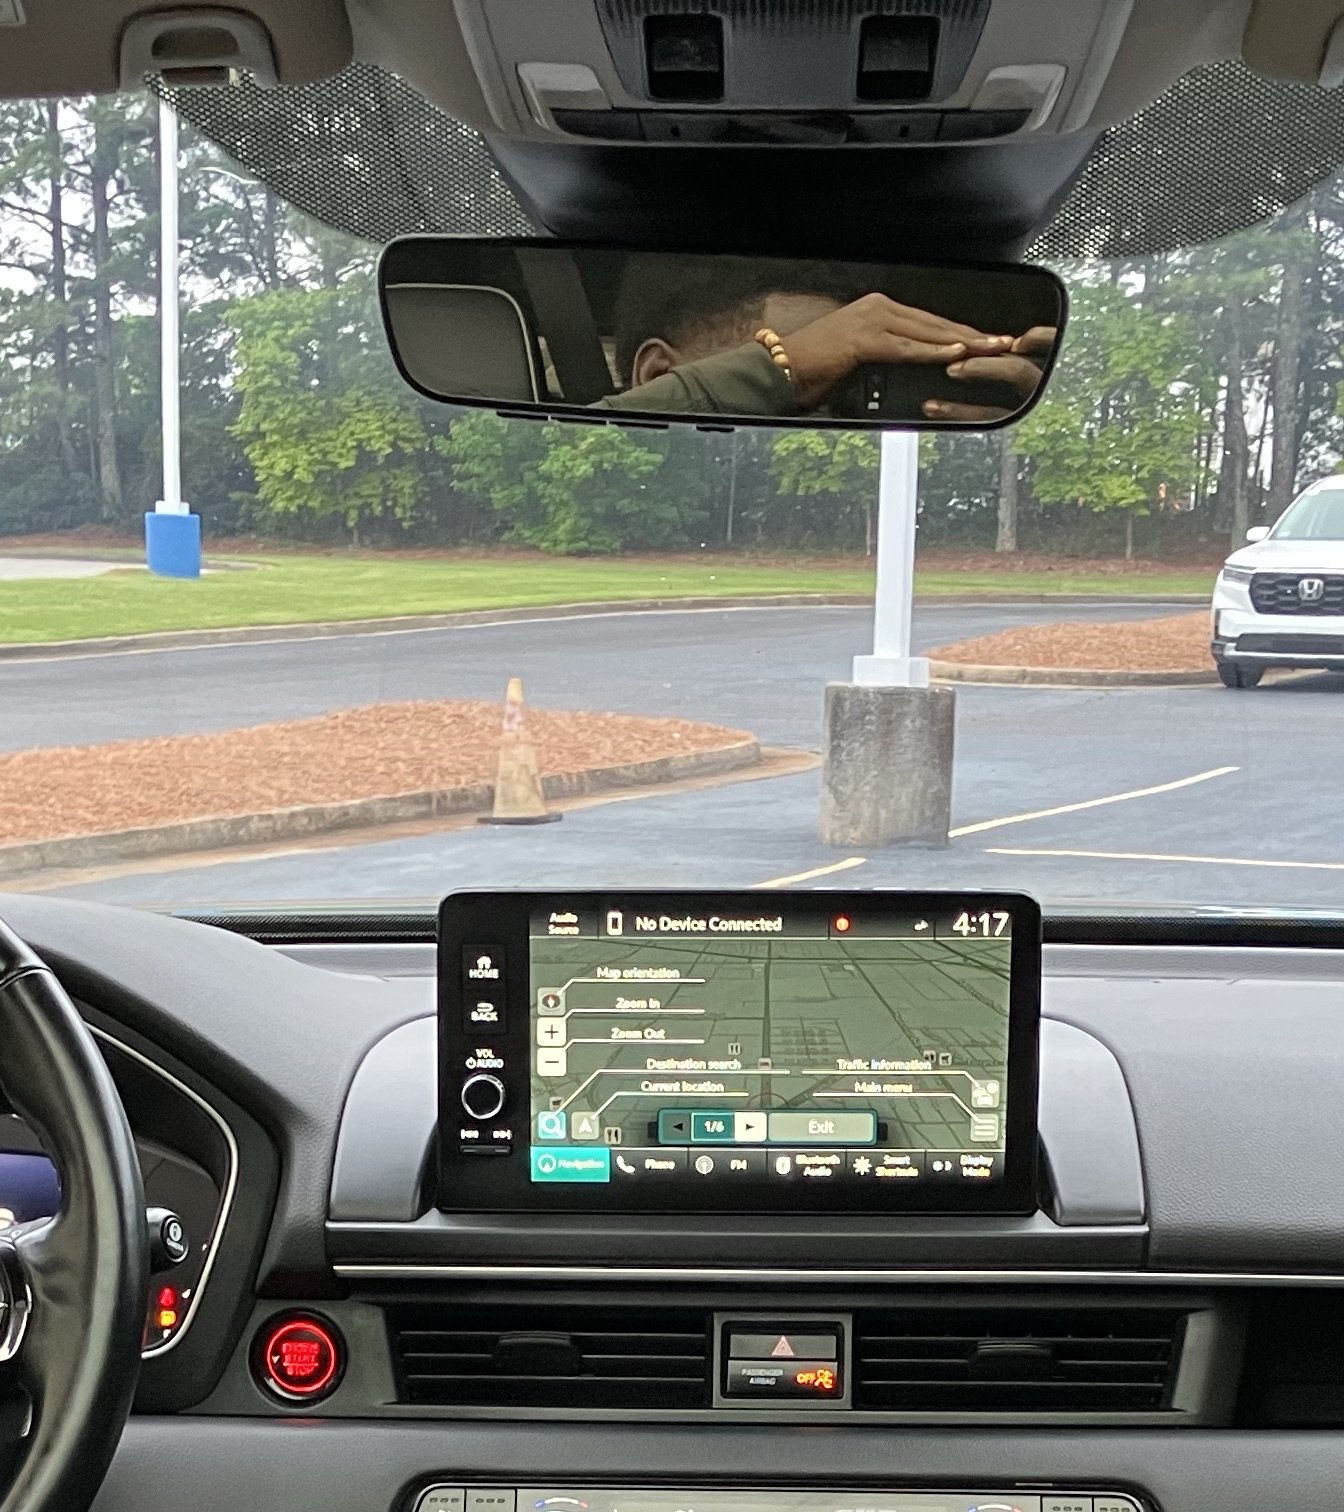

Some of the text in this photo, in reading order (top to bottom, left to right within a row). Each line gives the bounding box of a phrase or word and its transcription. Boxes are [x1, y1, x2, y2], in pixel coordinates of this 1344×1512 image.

[549, 913, 578, 924] Audio
[635, 916, 783, 932] No Device Connected
[953, 912, 1009, 936] 4:17
[469, 969, 499, 978] HOME
[597, 967, 680, 979] Map orientation
[615, 998, 647, 1009] Zoom
[471, 1011, 498, 1021] BACK
[611, 1028, 666, 1039] Zoom Out
[476, 1049, 495, 1058] VOL
[646, 1058, 742, 1070] Destination search
[836, 1059, 932, 1070] Traffic information
[640, 1081, 725, 1092] Current location
[854, 1081, 913, 1093] Main menu
[704, 1120, 725, 1133] 1/6
[808, 1119, 834, 1134] Exit
[644, 1159, 676, 1171] Phone
